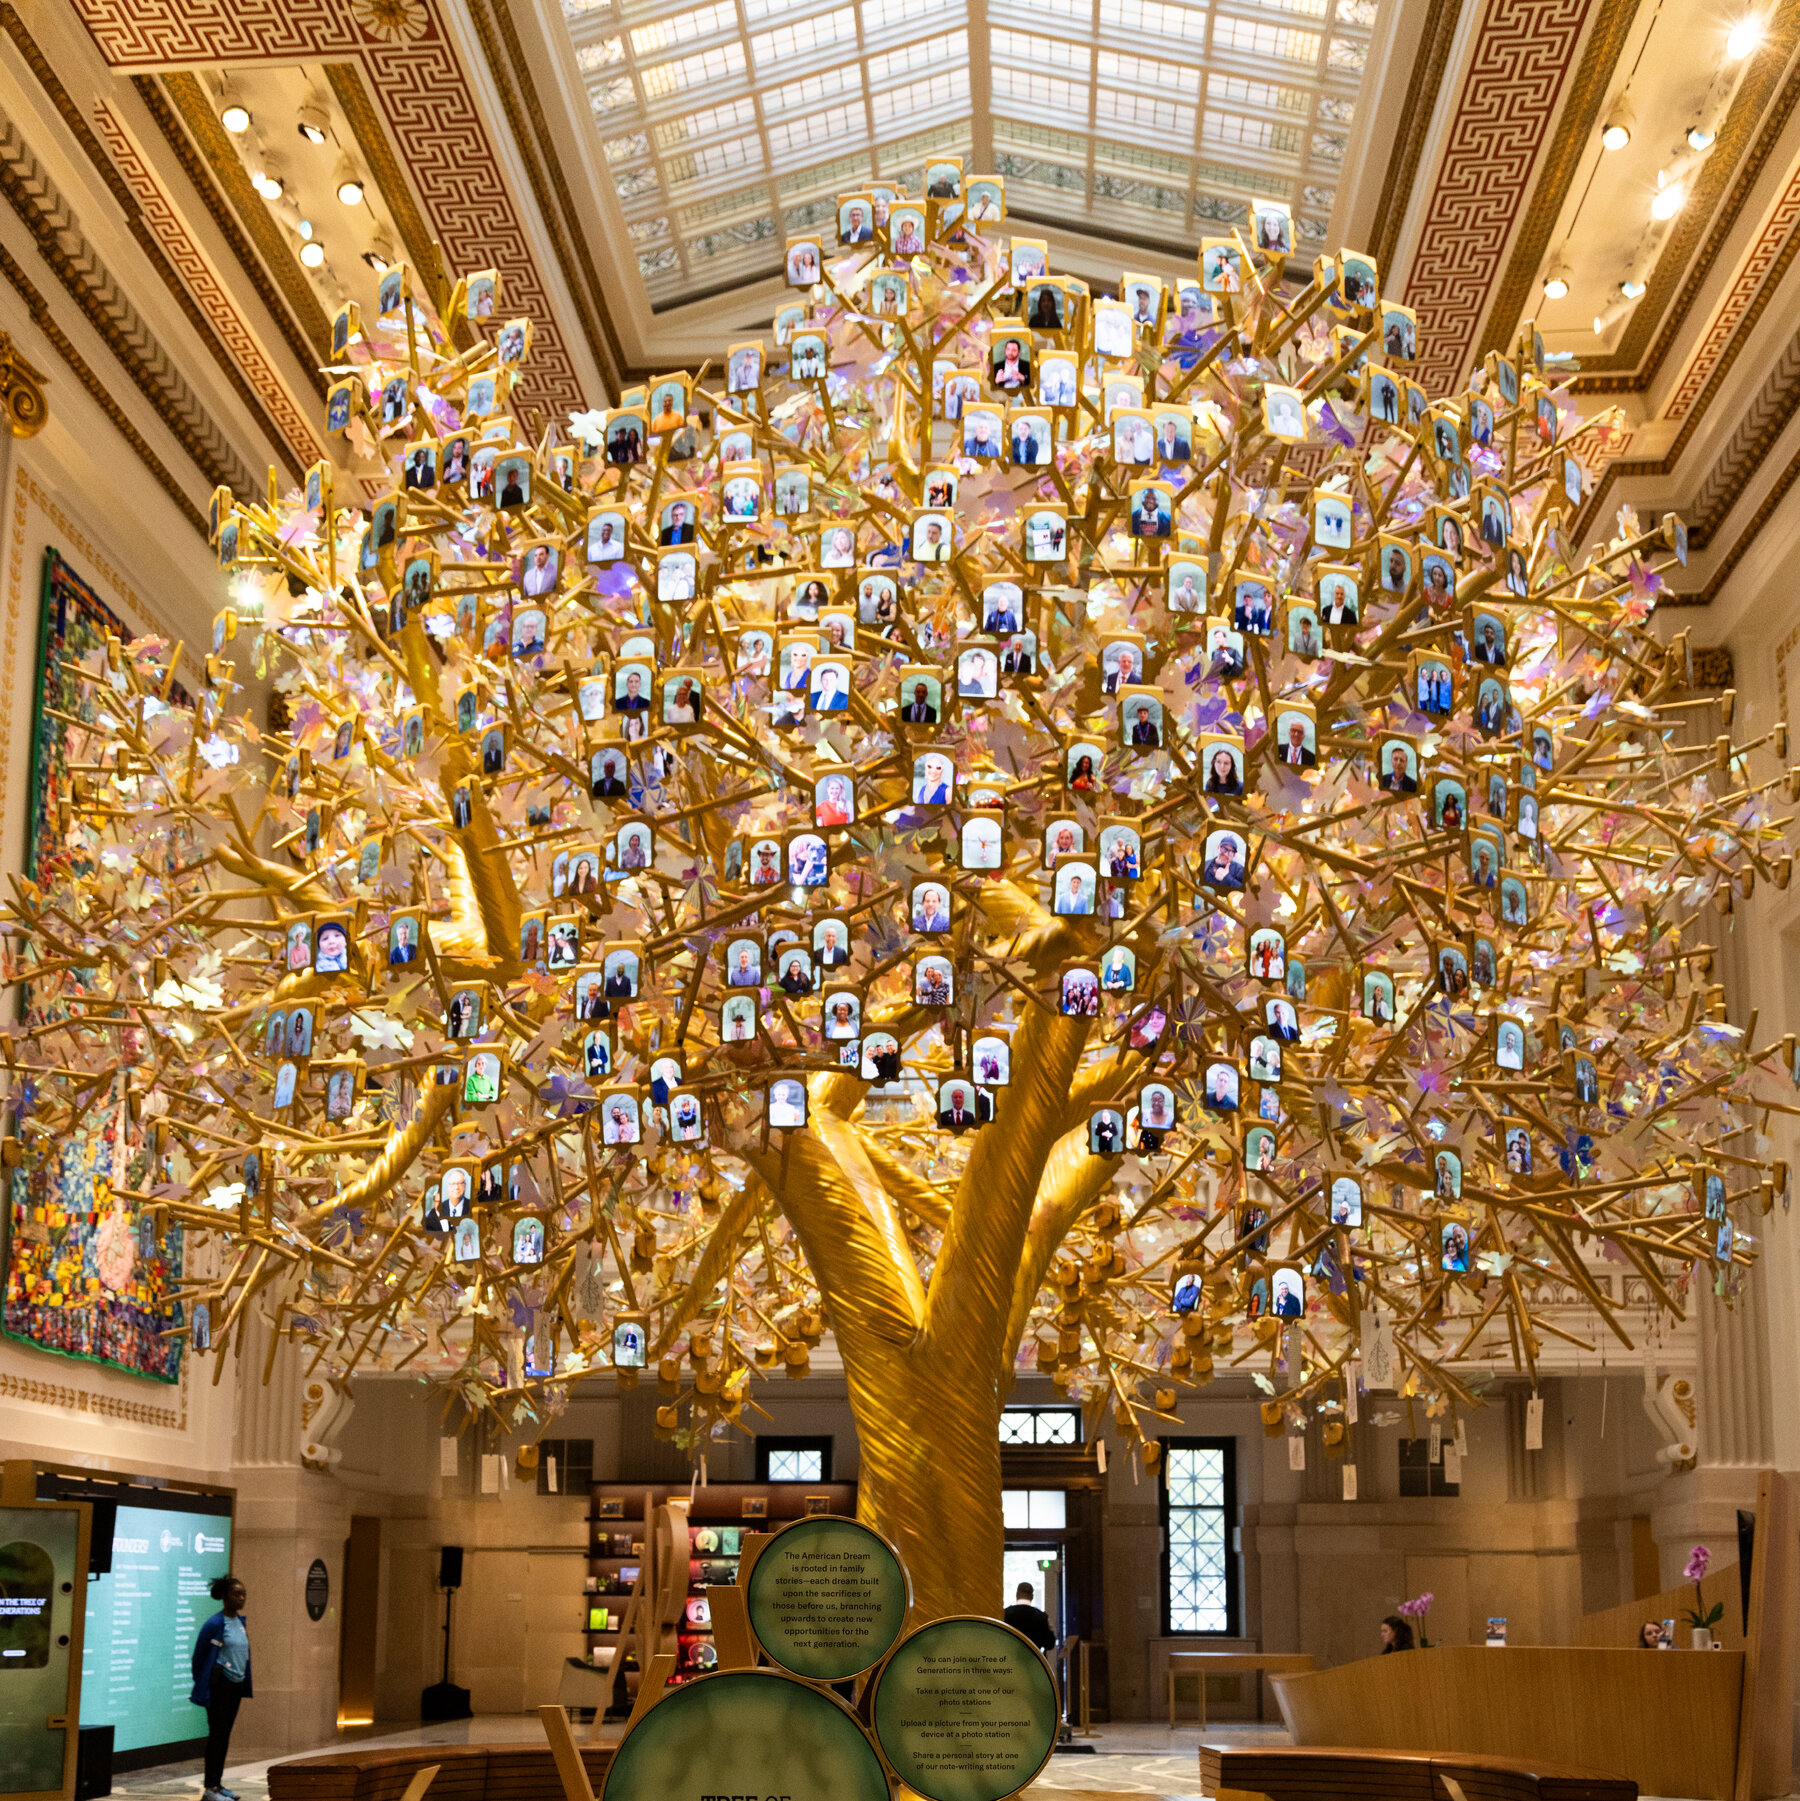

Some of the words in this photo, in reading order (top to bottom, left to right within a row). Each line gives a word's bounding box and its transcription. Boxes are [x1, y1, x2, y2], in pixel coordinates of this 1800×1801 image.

[785, 1552, 800, 1560] The
[802, 1552, 841, 1560] American
[844, 1552, 870, 1560] Dream
[840, 1565, 865, 1574] family
[832, 1577, 858, 1585] dream
[860, 1577, 879, 1585] built
[783, 1591, 803, 1599] upon
[772, 1602, 795, 1610] those
[797, 1602, 823, 1610] before
[840, 1602, 882, 1612] branching
[780, 1615, 816, 1624] upwards
[784, 1627, 840, 1636] opportunities
[842, 1627, 854, 1635] for
[855, 1627, 869, 1635] the
[793, 1640, 811, 1648] next
[813, 1640, 860, 1649] generation.
[952, 1656, 967, 1664] join
[916, 1687, 933, 1695] Take
[941, 1687, 967, 1696] picture
[992, 1687, 1000, 1695] of
[939, 1699, 961, 1707] photo
[961, 1731, 983, 1739] photo
[942, 1752, 974, 1760] personal
[975, 1752, 995, 1760] story
[939, 1763, 985, 1771] note-writing
